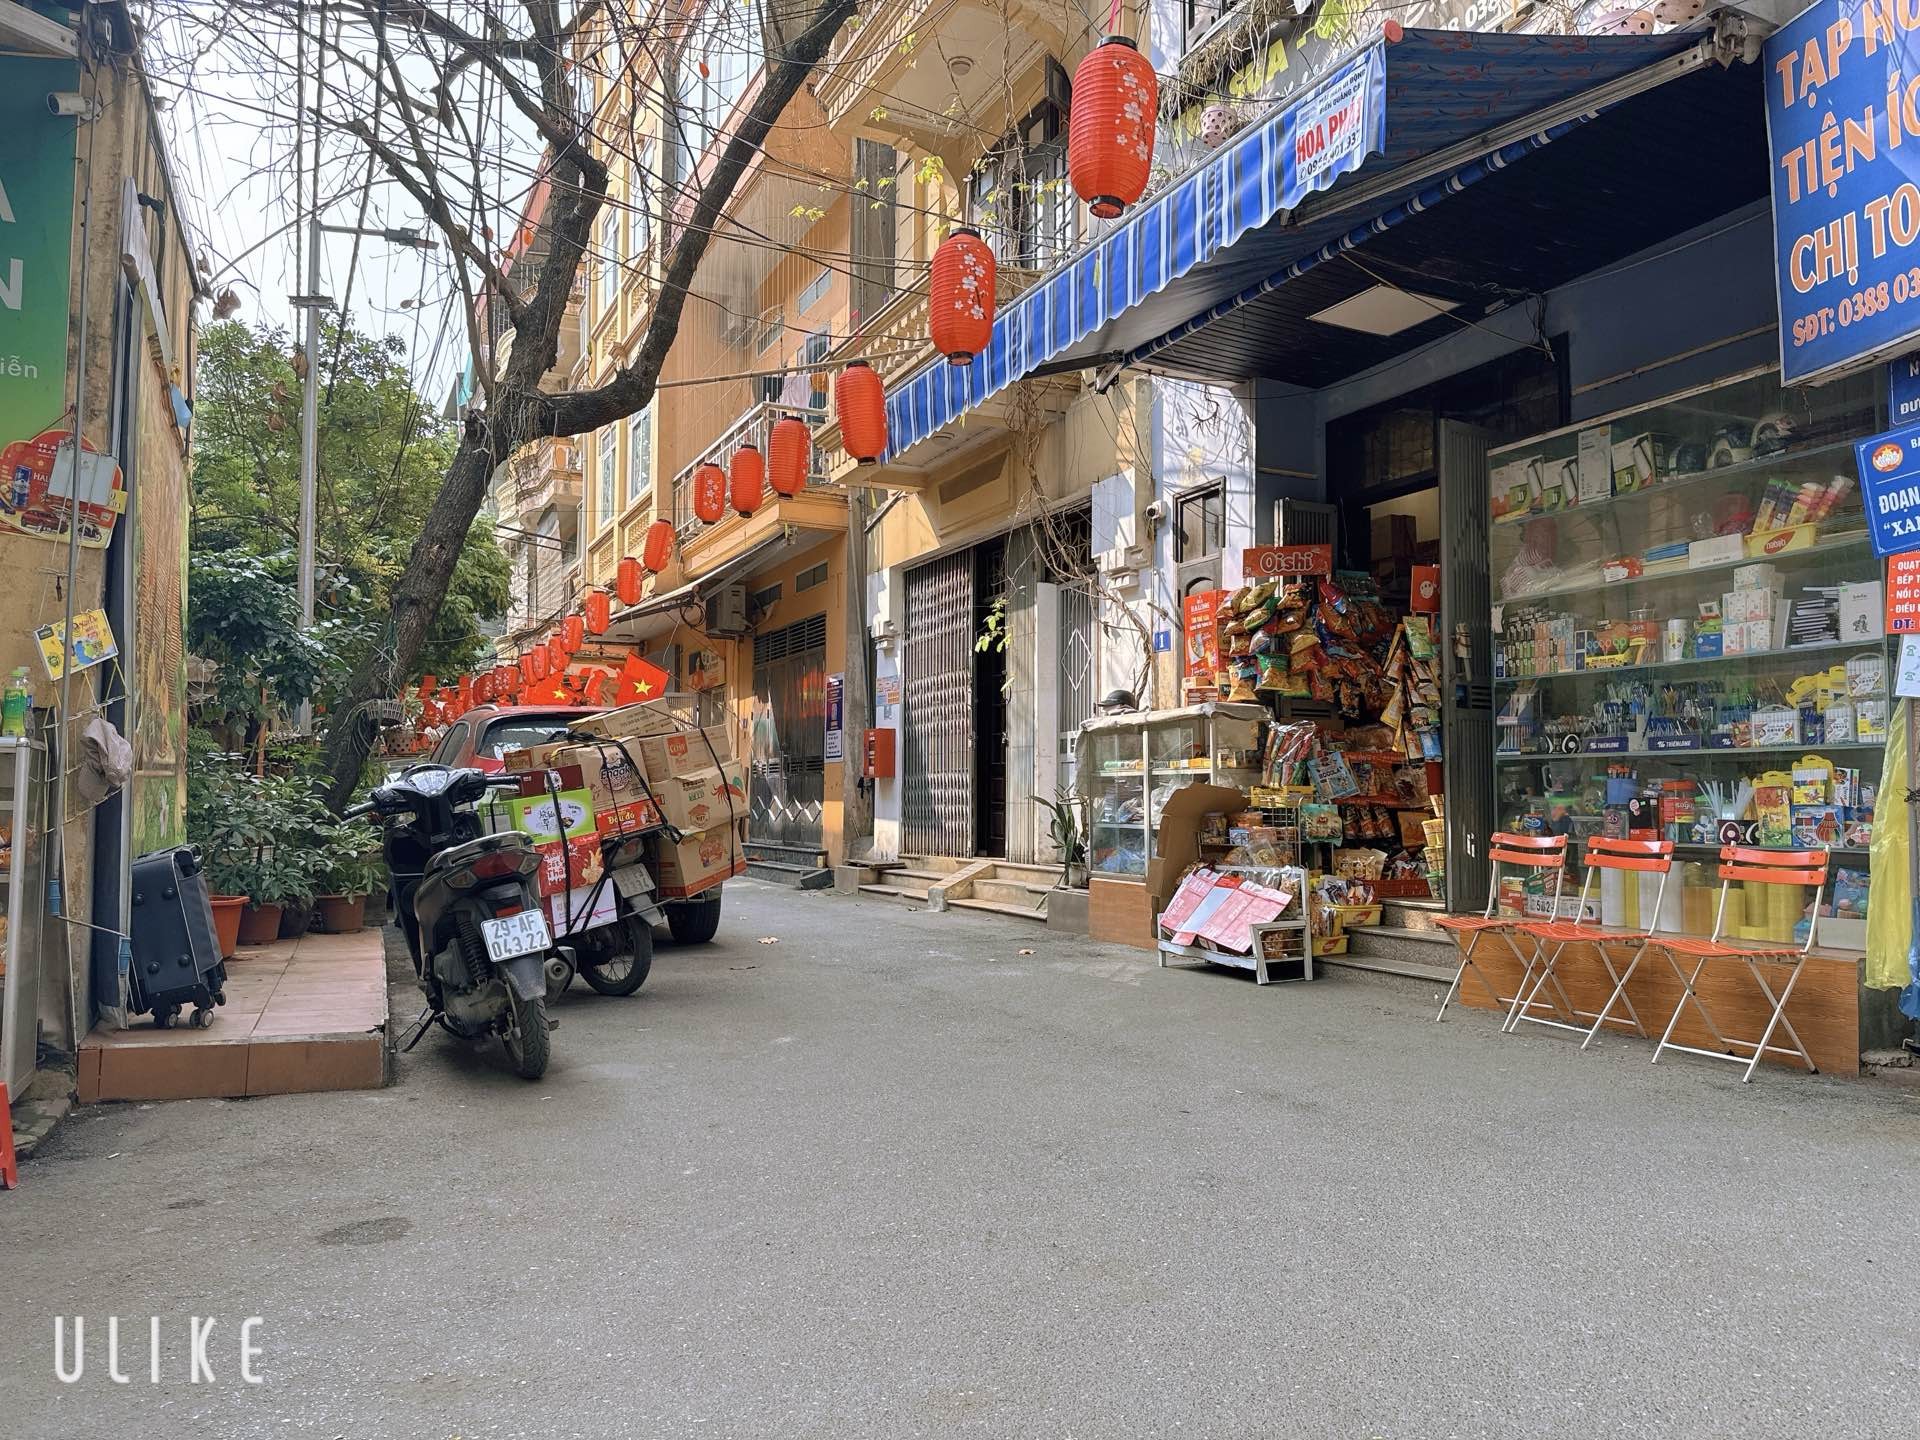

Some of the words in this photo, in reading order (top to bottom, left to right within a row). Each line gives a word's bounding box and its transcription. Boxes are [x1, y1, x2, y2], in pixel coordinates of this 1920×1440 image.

[1776, 17, 1853, 108] TẠP
[1781, 104, 1876, 205] TIỆN
[1790, 211, 1858, 294] CHỊ
[1792, 306, 1836, 347] SĐT:
[1838, 281, 1890, 328] 0388
[1260, 551, 1314, 574] Oishi
[491, 914, 536, 940] 29-AF
[491, 930, 547, 958] 043.22
